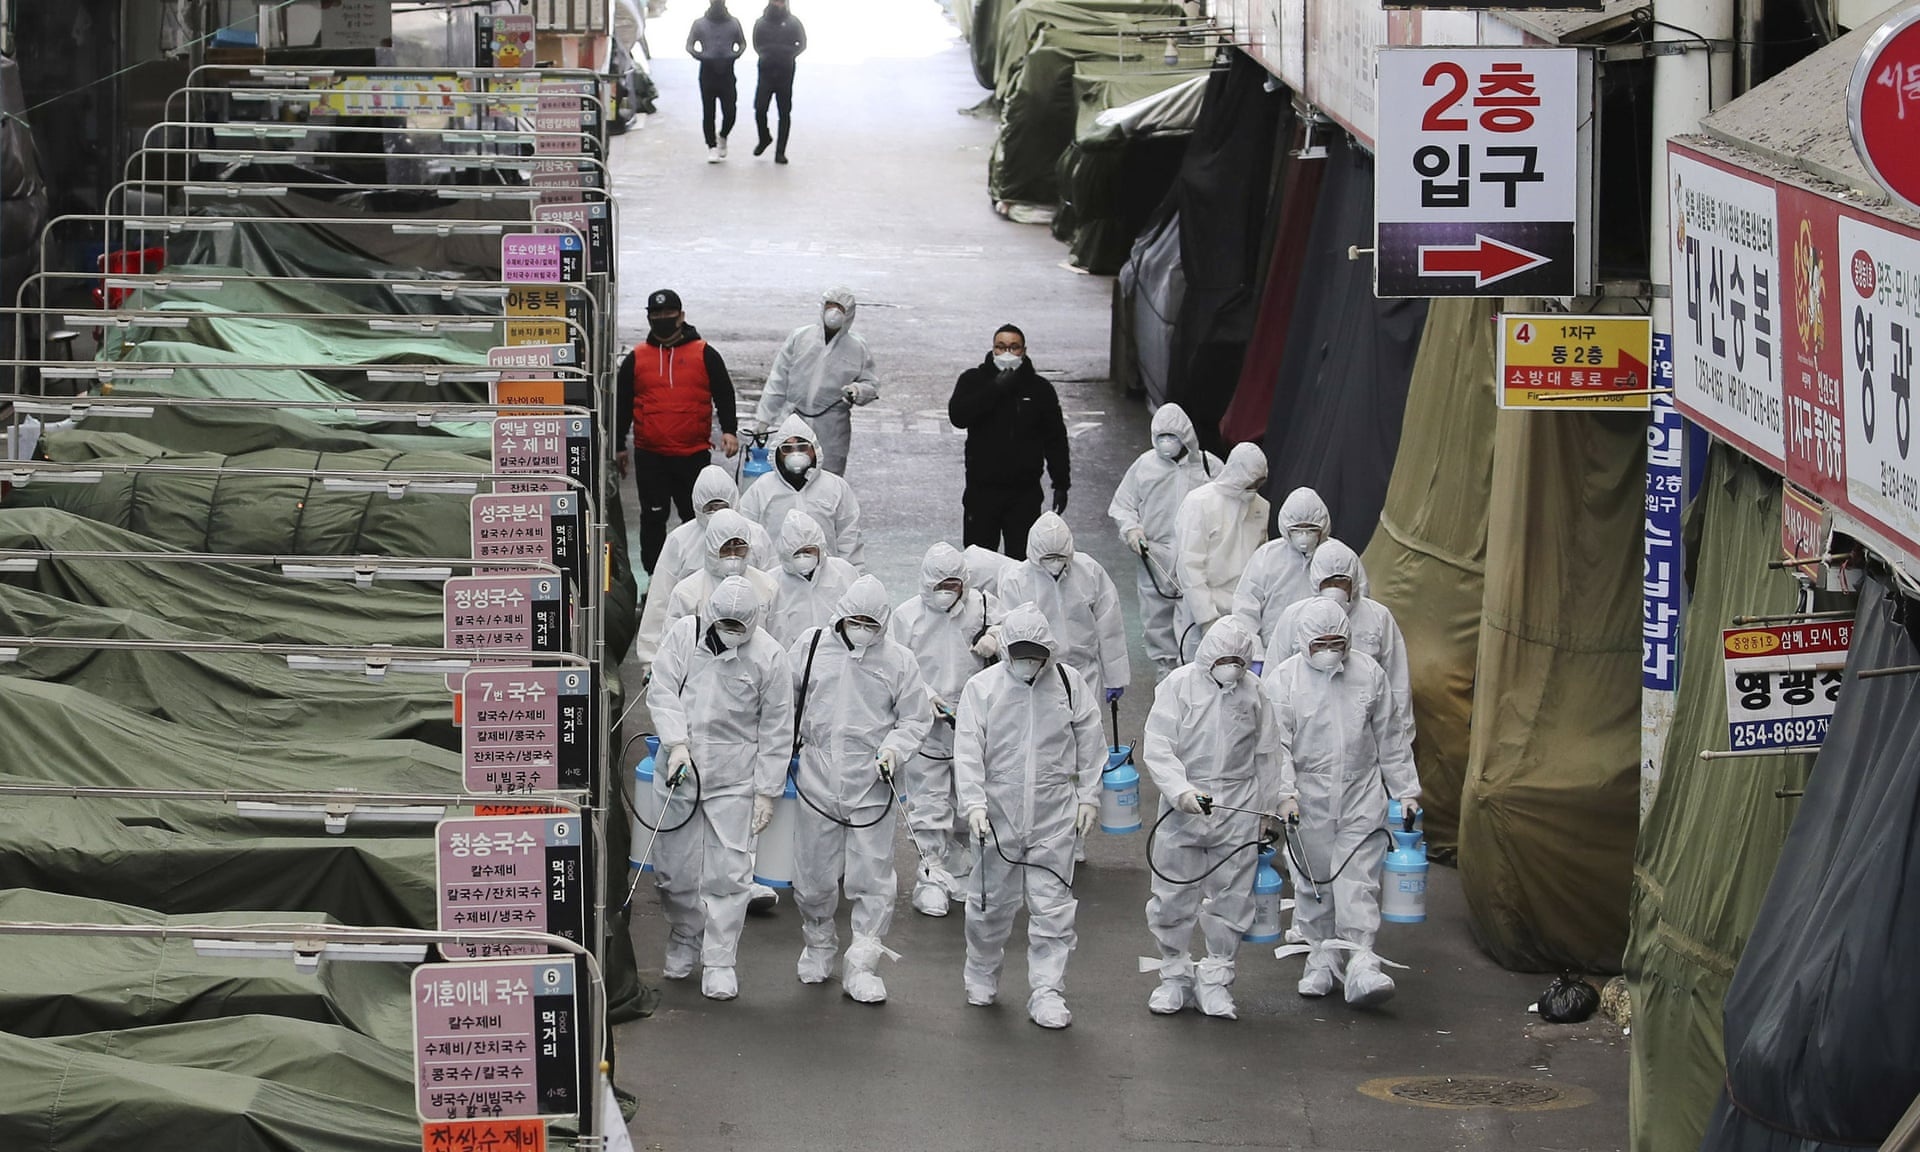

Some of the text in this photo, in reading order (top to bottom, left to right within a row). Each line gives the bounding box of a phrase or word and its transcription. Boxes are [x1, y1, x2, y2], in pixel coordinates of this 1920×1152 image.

[1421, 61, 1541, 133] 2층
[1412, 143, 1545, 208] 입구
[507, 291, 561, 310] 아동복
[1686, 235, 1772, 382] 대신승복
[1516, 323, 1531, 343] 4
[1560, 325, 1597, 340] 1지구
[1551, 345, 1604, 365] 동 2층
[1510, 370, 1603, 388] 소방대 통로
[1854, 304, 1913, 461] 영광
[500, 421, 561, 436] 옛날 엄마
[1788, 395, 1842, 482] 1지구 중앙동
[511, 483, 549, 493] 잔치국수
[479, 504, 544, 523] 성주분식
[480, 527, 543, 539] 칼국수/수제비
[555, 525, 566, 557] 먹거리
[481, 544, 544, 556] 콩국수/냉국수
[454, 588, 525, 609] 정성국수
[455, 614, 524, 626] 칼국수/수제비
[537, 611, 548, 647] 먹거리
[455, 633, 524, 645] 콩국수/냉국수
[1734, 636, 1774, 650] 중앙동1호
[568, 676, 575, 686] 6
[480, 681, 546, 703] 7번 국수
[477, 710, 546, 722] 칼국수/수제비
[563, 706, 575, 745] 먹거리
[1734, 719, 1817, 747] 254-8692
[477, 730, 546, 742] 칼제비/콩국수
[473, 750, 554, 762] 잔치국수/냉국수
[557, 824, 565, 835] 6
[449, 830, 537, 857] 청송국수
[471, 863, 517, 878] 칼수제비
[567, 860, 576, 881] Food
[552, 859, 565, 903] 먹거리
[447, 886, 542, 901] 칼국수/잔치국수
[454, 909, 537, 925] 수제비/냉국수
[548, 971, 556, 984] 6
[423, 978, 529, 1008] 기훈이네 국수
[448, 1015, 502, 1030] 칼수제비
[559, 1010, 568, 1034] Food
[542, 1010, 557, 1058] 먹거리
[425, 1039, 528, 1056] 수제비/잔치국수
[431, 1065, 524, 1081] 콩국수/칼국수
[430, 1090, 527, 1107] 냉국수/비빔국수
[546, 1087, 568, 1098] 小吃
